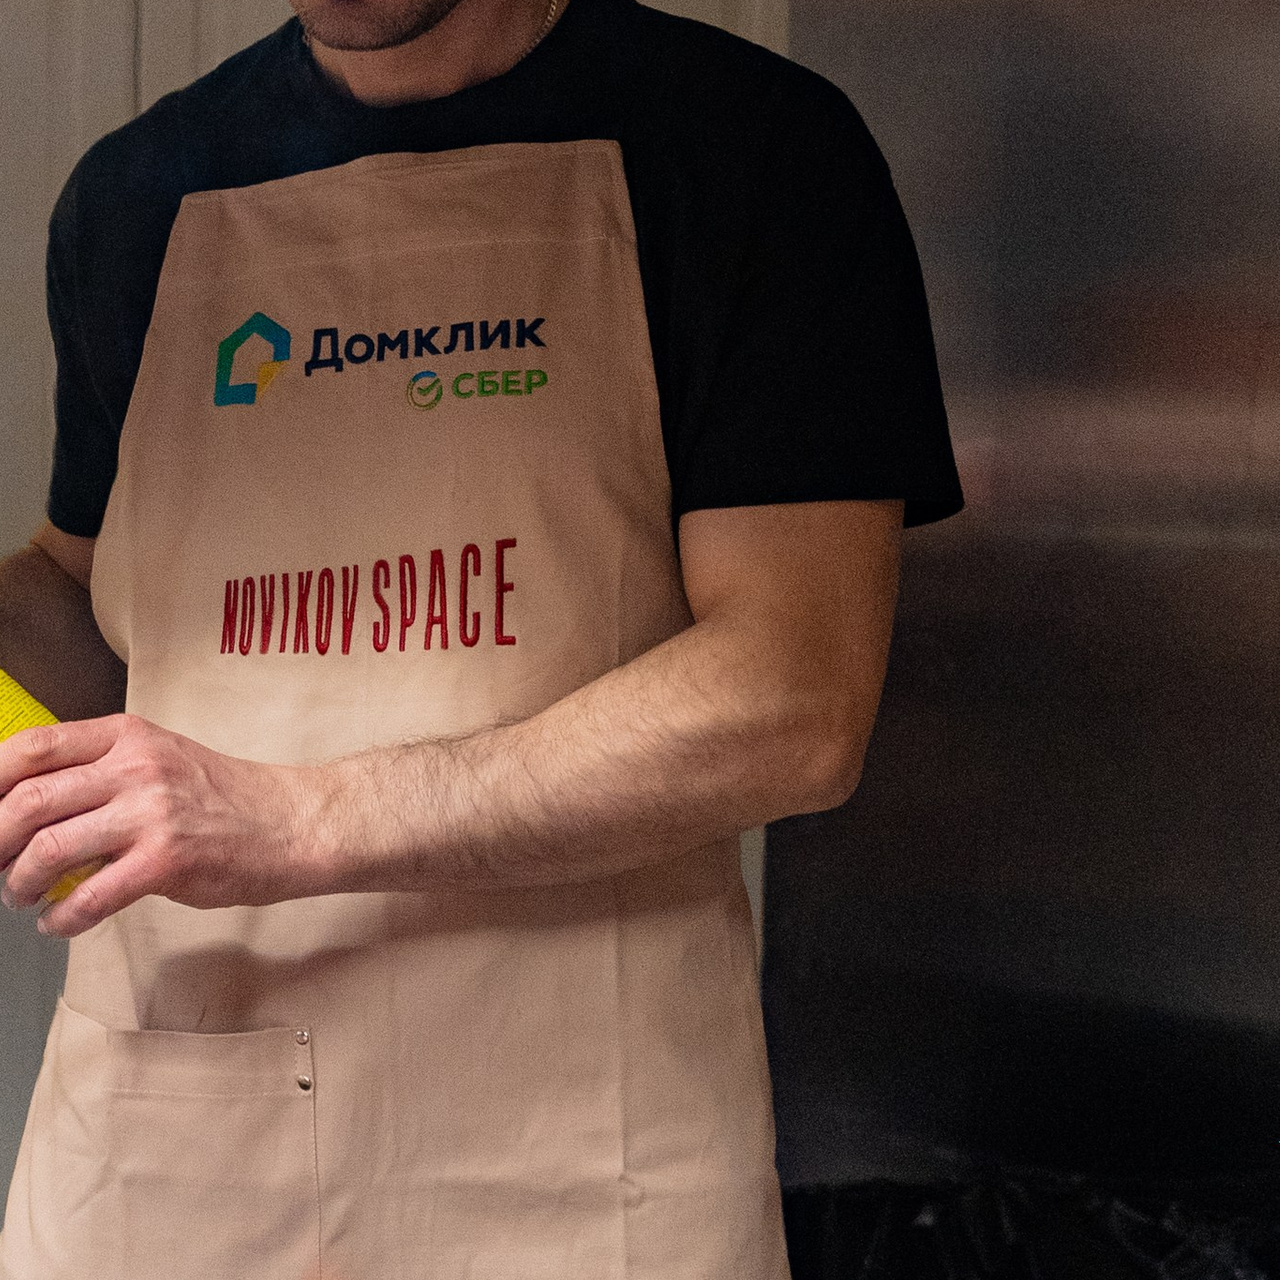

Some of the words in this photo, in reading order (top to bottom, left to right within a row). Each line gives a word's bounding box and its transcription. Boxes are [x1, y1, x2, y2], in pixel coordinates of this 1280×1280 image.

[451, 369, 549, 400] СБЕР
[220, 564, 360, 656] NOVIKOV
[372, 537, 517, 653] SPACE
